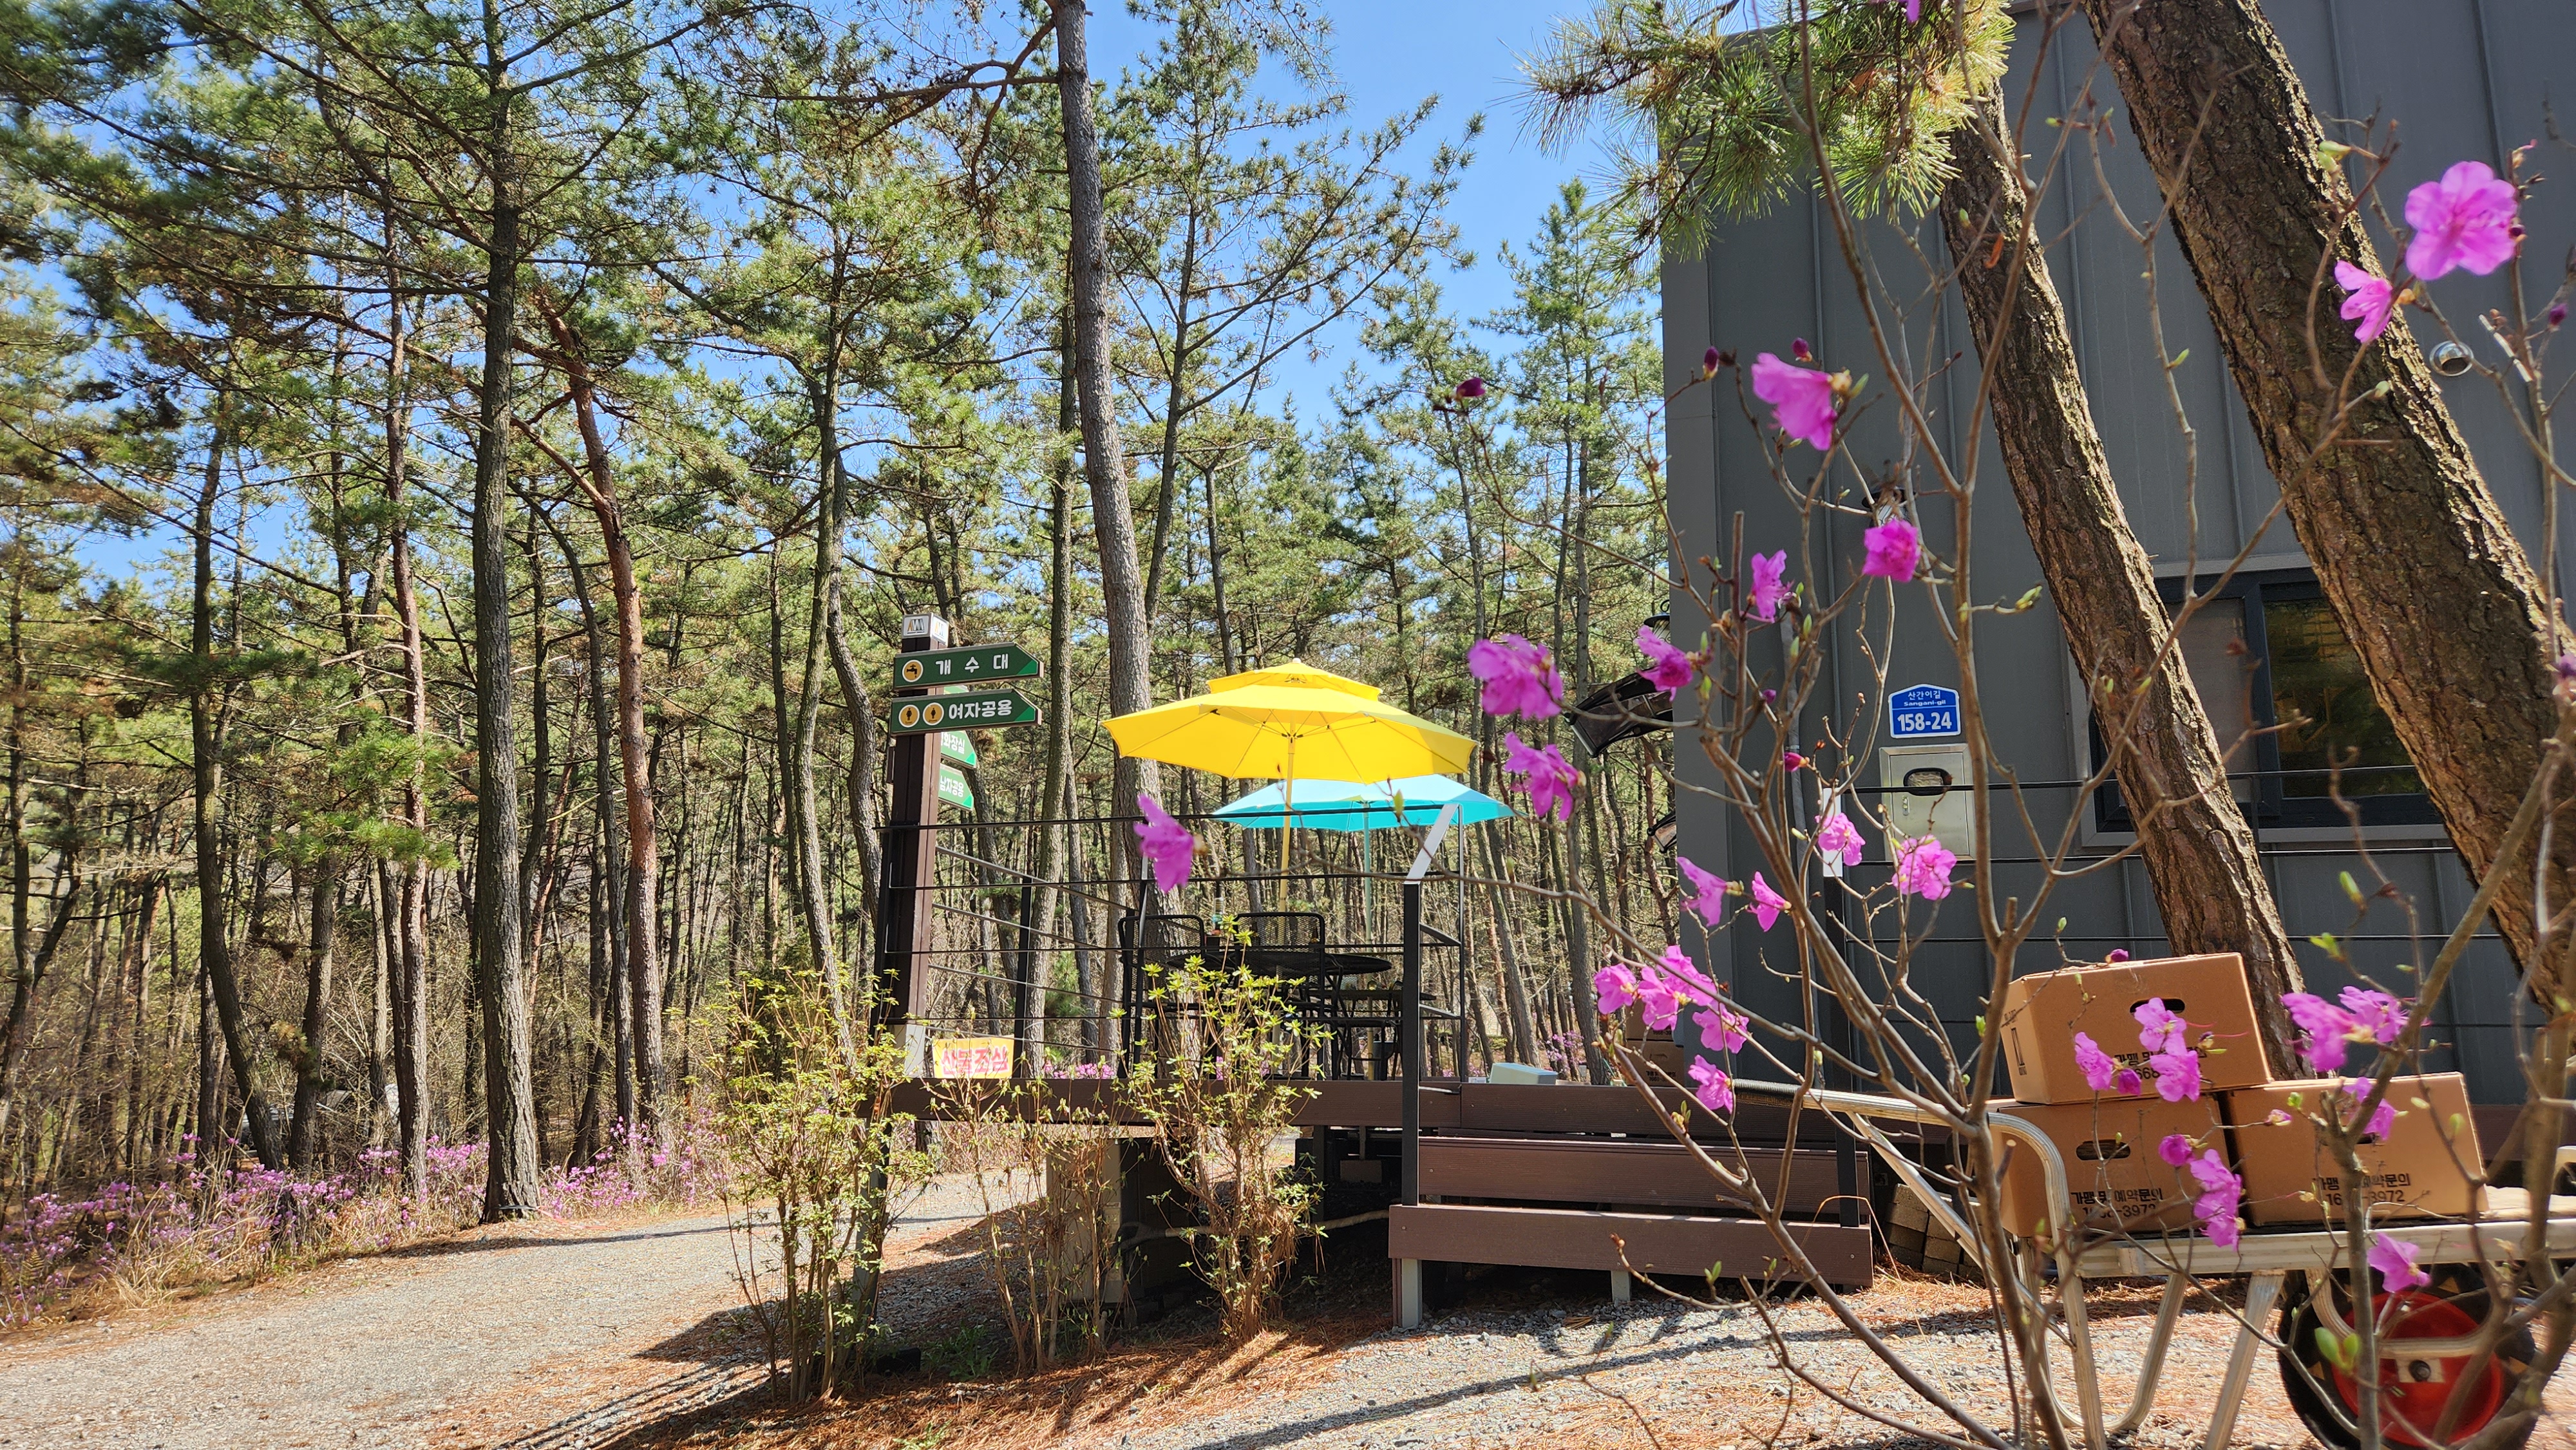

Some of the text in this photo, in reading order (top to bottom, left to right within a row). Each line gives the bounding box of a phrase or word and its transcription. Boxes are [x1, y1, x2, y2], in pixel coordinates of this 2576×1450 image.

[1908, 690, 1941, 701] 산간이길
[949, 699, 1012, 719] 여자공용
[1897, 711, 1952, 731] 158-24
[941, 732, 965, 755] 화장실
[940, 775, 964, 798] 남자공용
[2071, 1191, 2096, 1205] 가맹
[2114, 1188, 2163, 1202] 예약문의
[2326, 1190, 2405, 1205] 16-3972
